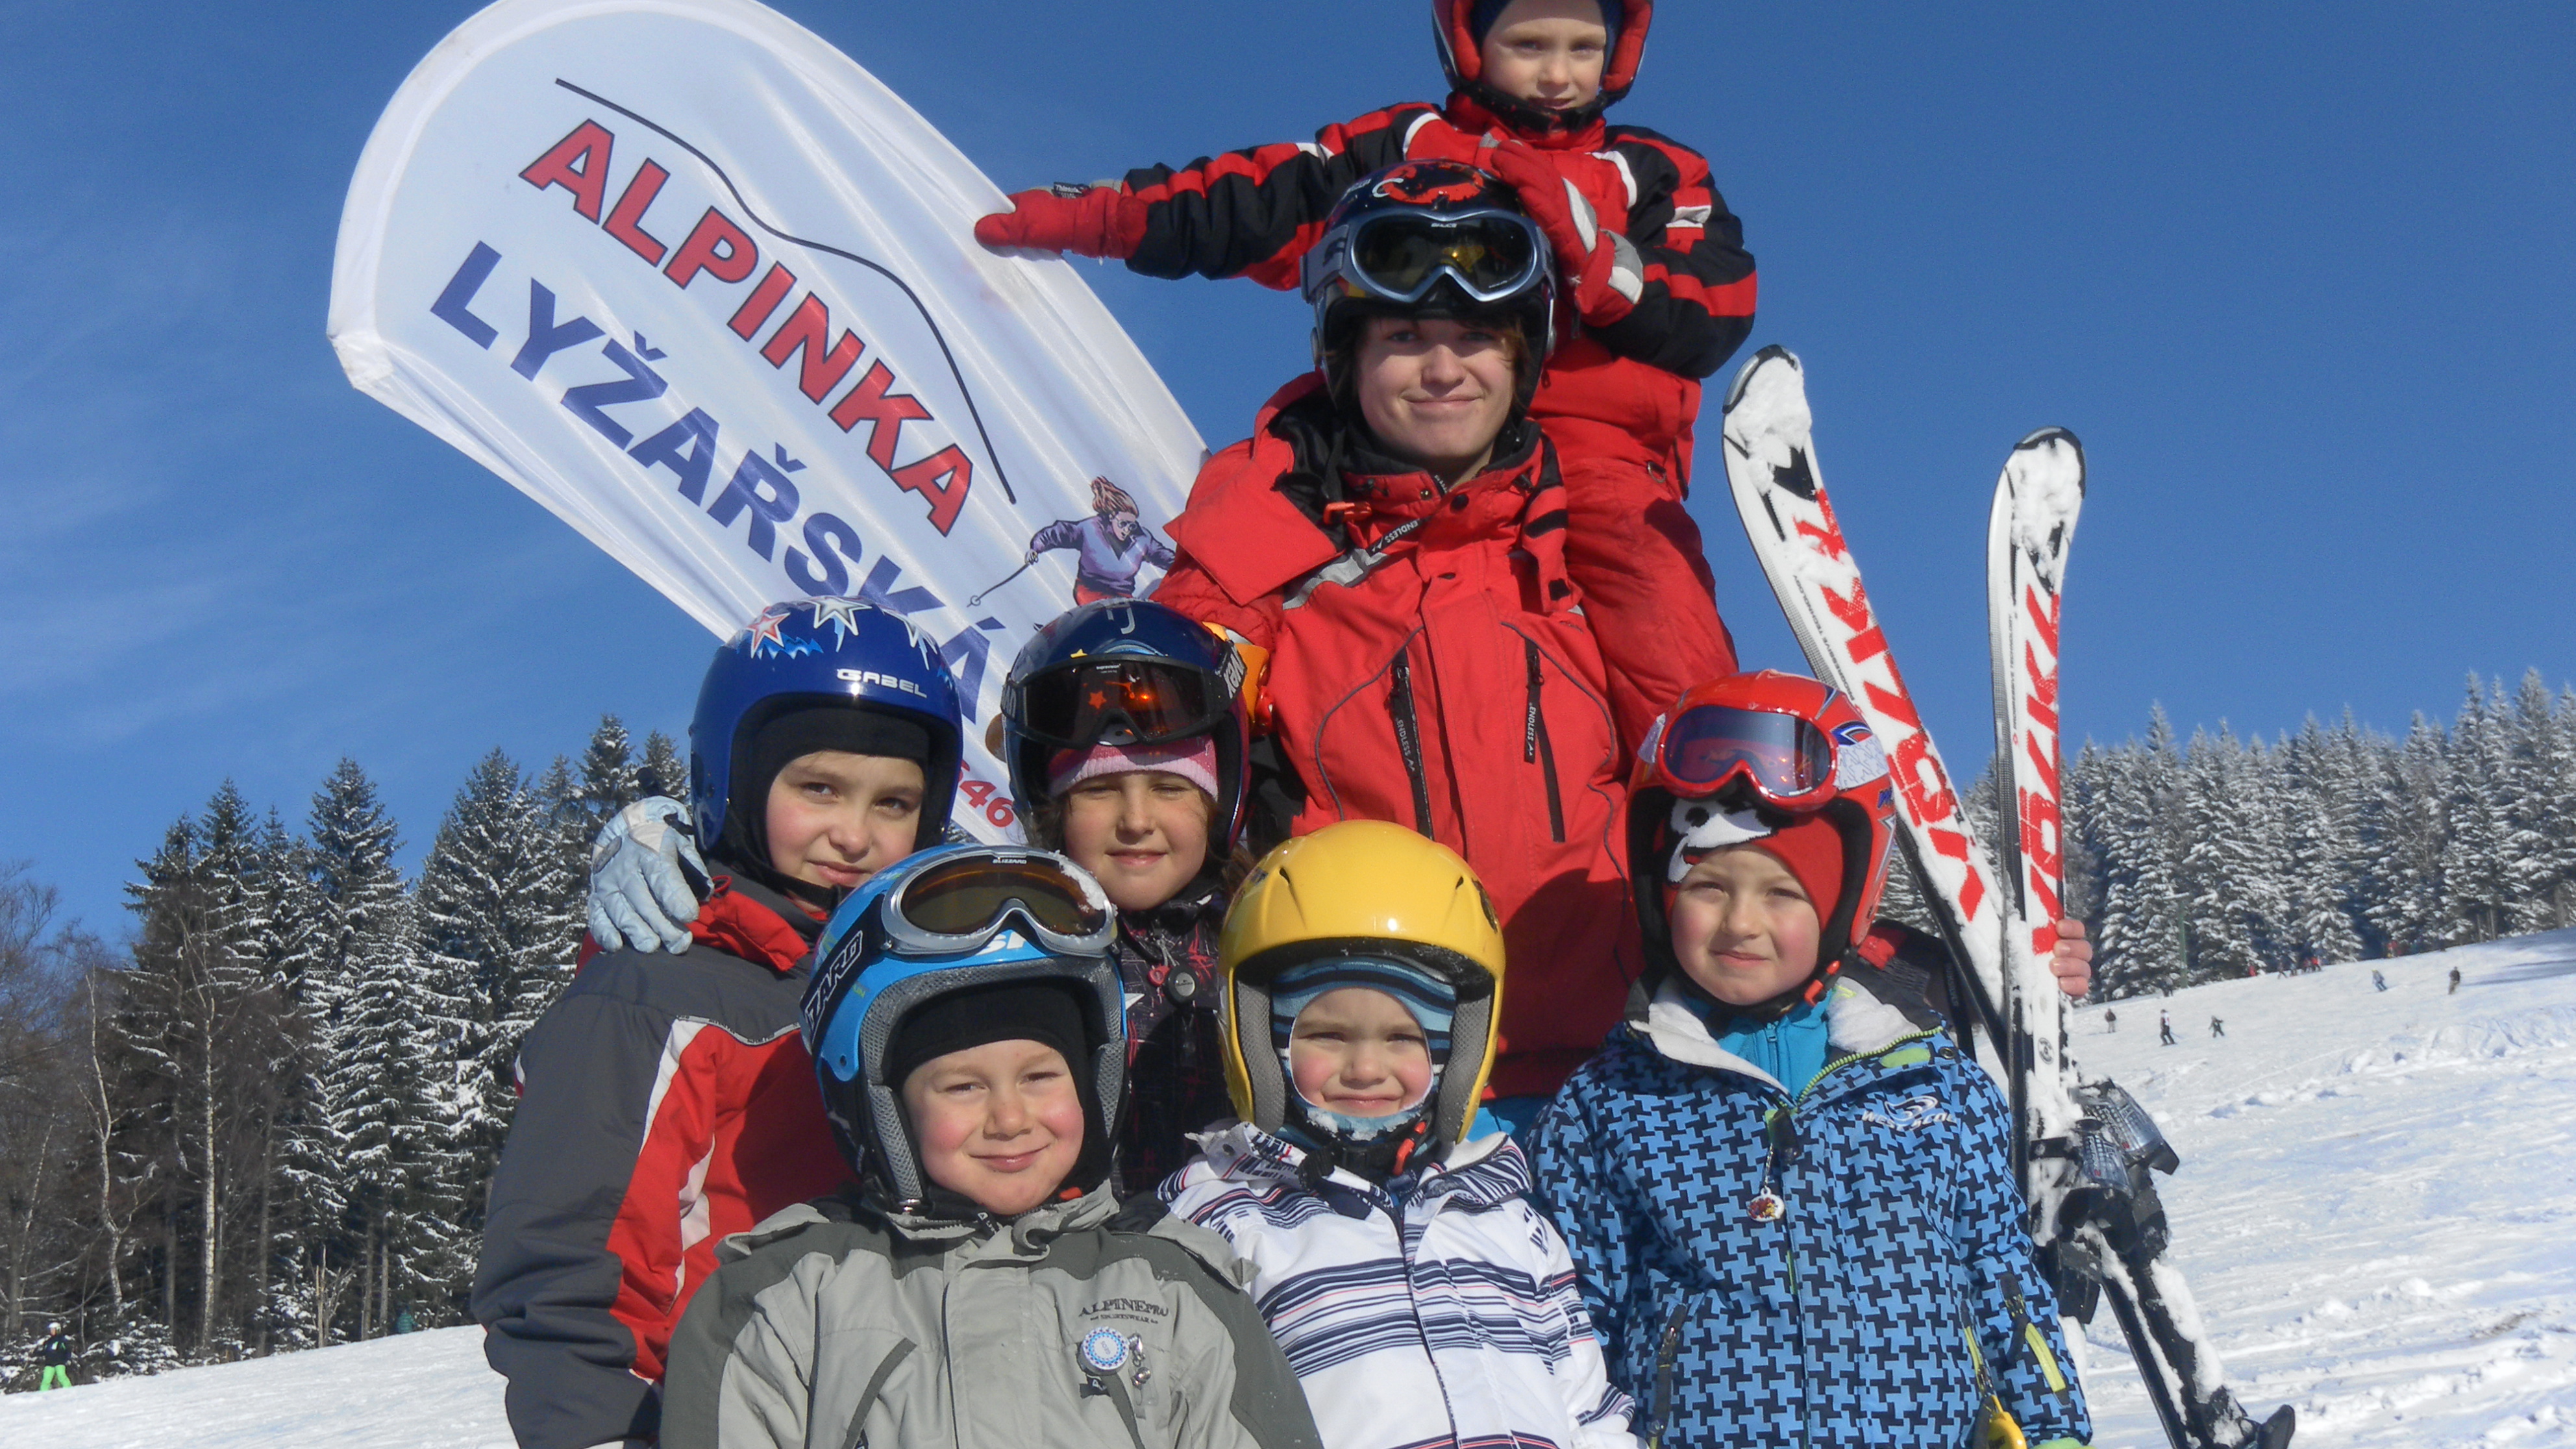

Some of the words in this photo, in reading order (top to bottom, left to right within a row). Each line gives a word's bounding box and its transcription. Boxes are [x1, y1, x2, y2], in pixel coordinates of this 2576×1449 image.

[519, 119, 972, 537] ALPINKA
[430, 241, 1006, 725] LYŽAŘSKÁ
[1384, 519, 1419, 544] ENDLESS
[1792, 573, 1825, 636] TECHNOLOGY
[837, 669, 927, 699] GABEL
[1821, 636, 1855, 701] PROGRESSIVE
[1397, 717, 1411, 755] ENDLESS
[1526, 706, 1537, 741] ENDLESS
[958, 759, 1014, 828] 46
